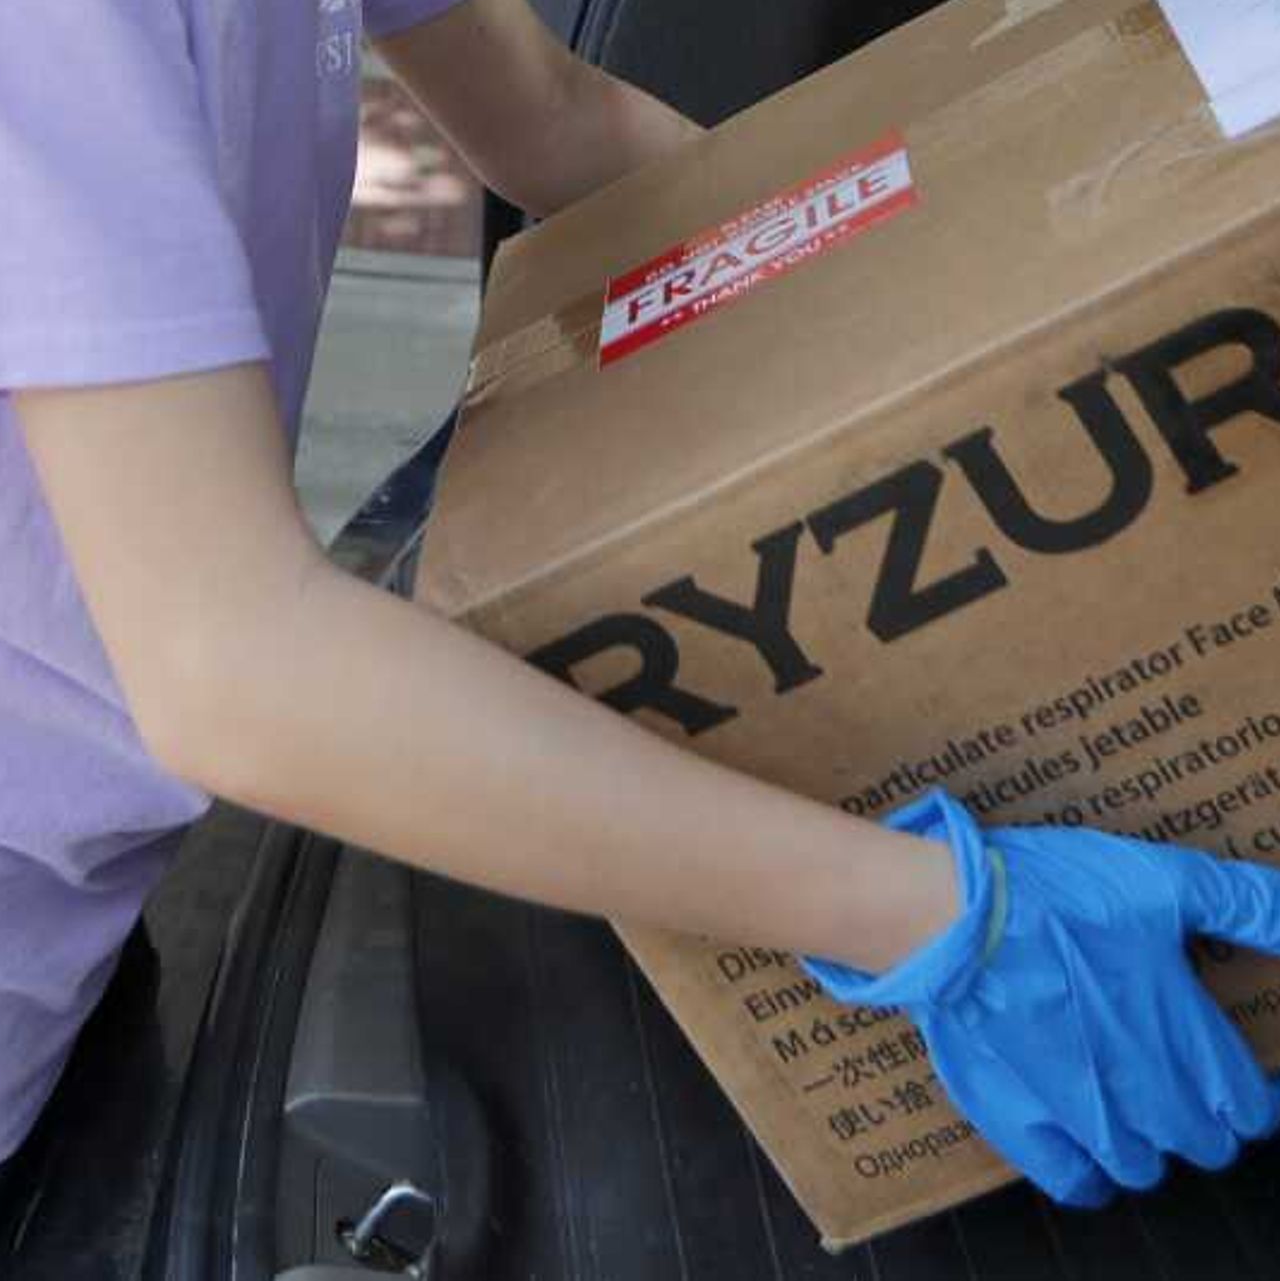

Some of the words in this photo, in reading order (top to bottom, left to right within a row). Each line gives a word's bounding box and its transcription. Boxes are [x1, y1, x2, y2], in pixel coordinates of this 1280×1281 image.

[627, 170, 891, 325] FRAGILE
[693, 273, 762, 316] THANK
[839, 722, 1019, 817] particulate
[1021, 641, 1187, 737] respirator
[1185, 601, 1272, 658] Face
[966, 749, 1081, 815] ticules
[1078, 689, 1205, 772] jetable
[743, 977, 824, 1023] Einw
[829, 1071, 938, 1141] 使い捨
[853, 1120, 979, 1178] Однораз
